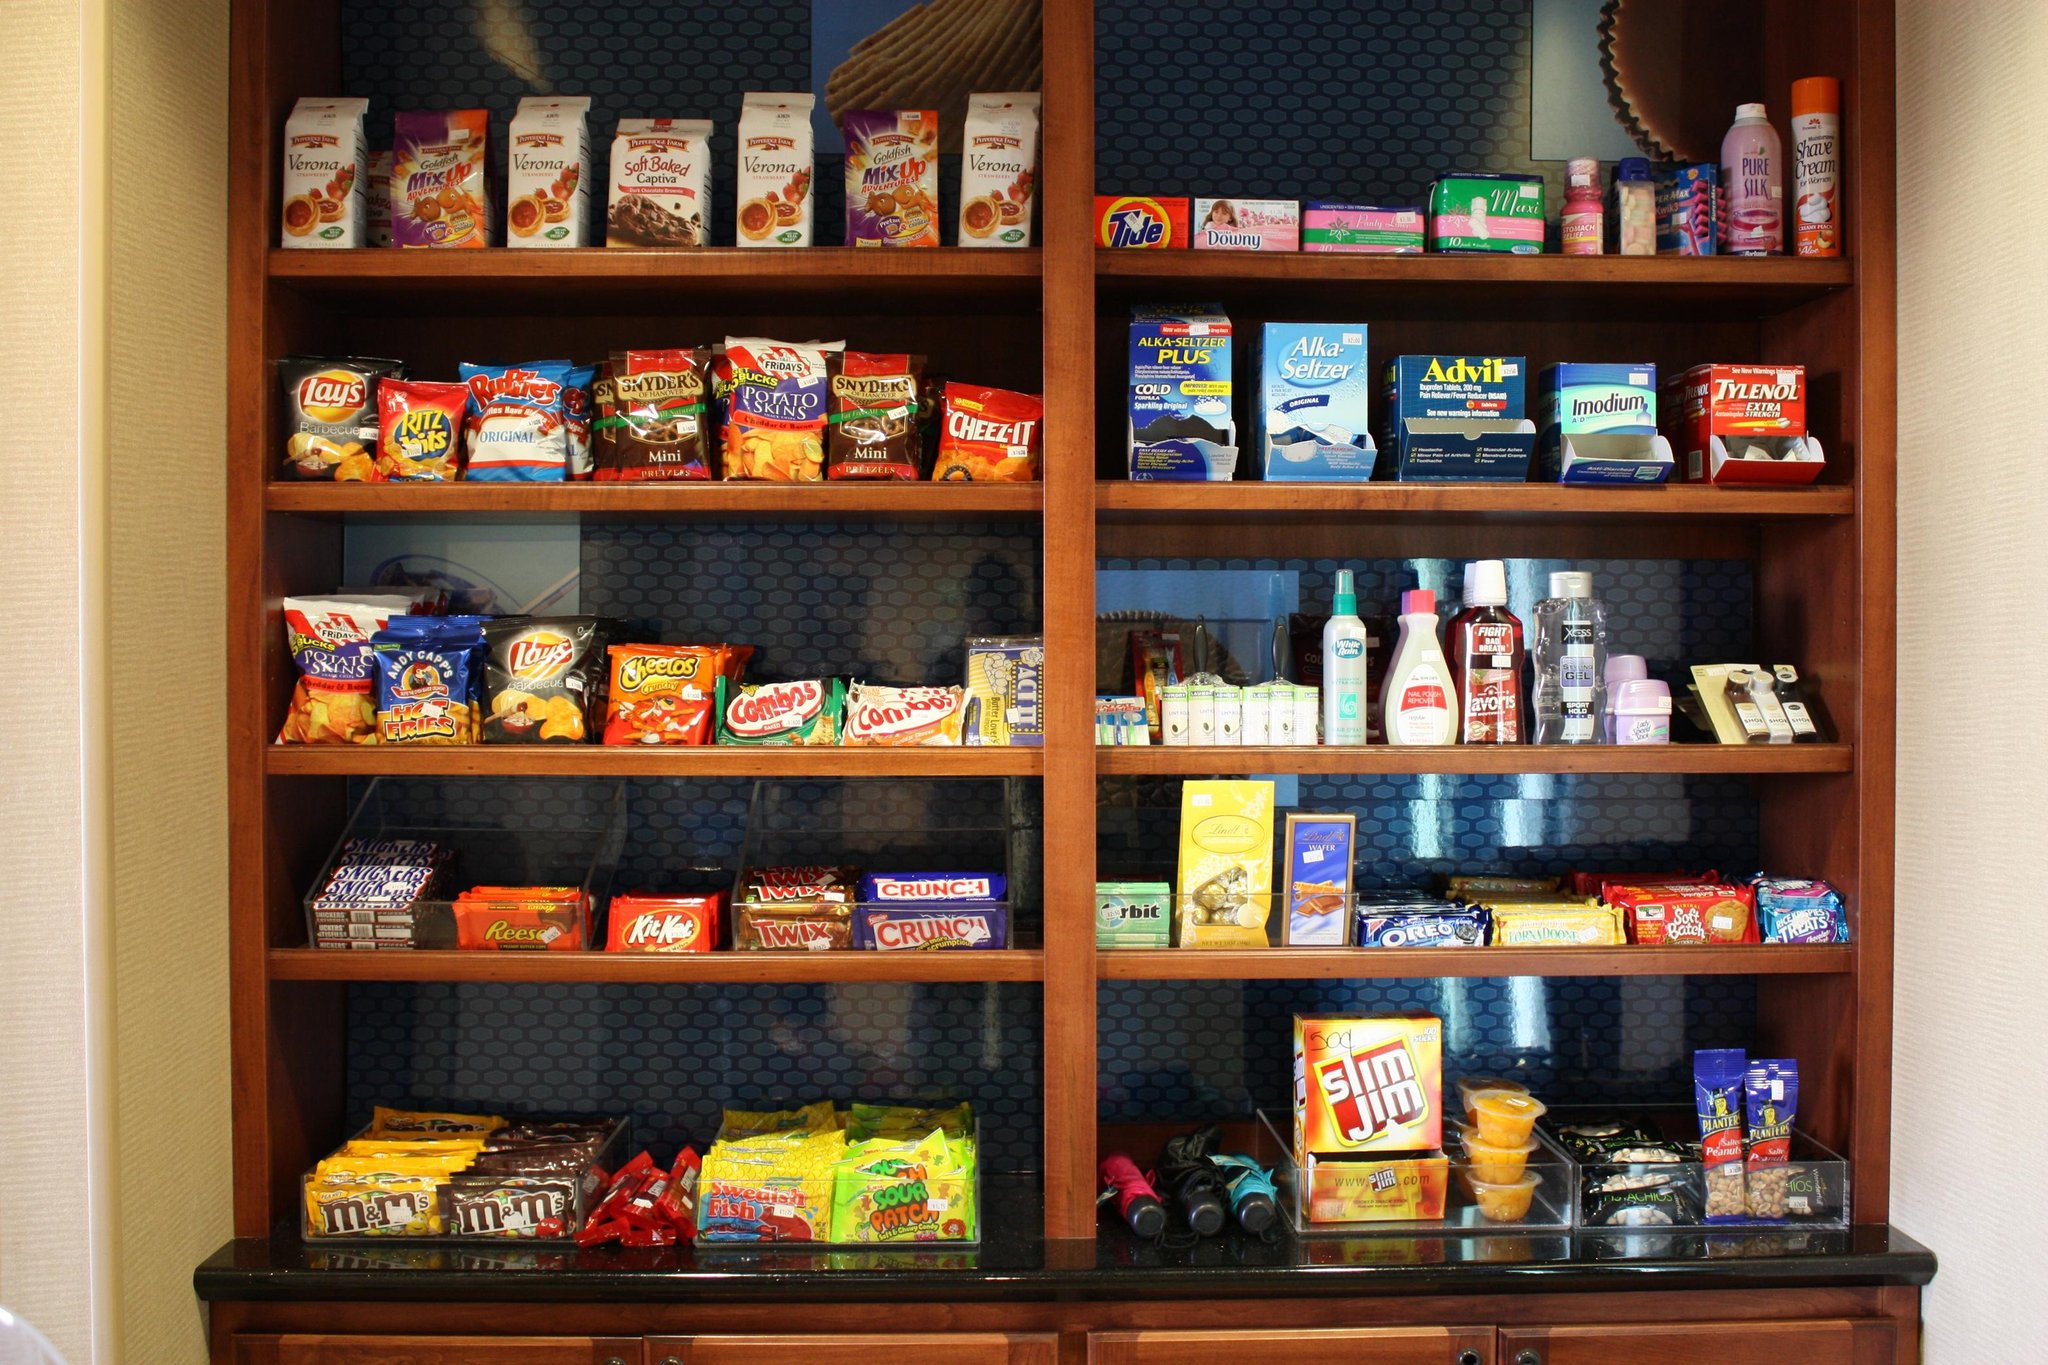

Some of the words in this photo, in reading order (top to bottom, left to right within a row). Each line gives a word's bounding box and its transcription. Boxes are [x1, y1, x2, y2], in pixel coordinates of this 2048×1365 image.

[631, 138, 666, 148] PEPPERIDGE
[667, 139, 683, 148] FARM
[1796, 139, 1833, 161] Shave
[289, 153, 340, 171] Verona
[420, 152, 459, 170] Goldfish
[513, 153, 564, 171] Verona
[873, 144, 912, 165] Goldfish
[968, 153, 1021, 172] Verona
[624, 155, 649, 176] Soft
[648, 155, 691, 177] Baked
[743, 156, 796, 174] Verona
[862, 156, 927, 186] Mix-Up
[1742, 157, 1770, 177] PURE
[1795, 159, 1836, 180] Cream
[406, 162, 472, 193] Mix-Up
[636, 173, 677, 186] Captiva
[1808, 176, 1832, 186] Women
[1744, 178, 1770, 201] SILK
[1490, 188, 1539, 216] Maxi
[1108, 208, 1165, 248] Tide
[1562, 224, 1596, 234] STOMACH
[1207, 229, 1261, 248] Downy
[1138, 337, 1226, 347] ALKA-SELTZER
[1291, 336, 1345, 358] Alka-
[1157, 349, 1212, 364] PLUS
[1281, 357, 1354, 380] Seltzer
[1420, 357, 1505, 383] Advil
[1731, 367, 1741, 375] See
[1752, 368, 1776, 376] Warnings
[622, 373, 699, 393] SNYDER'S
[738, 371, 779, 387] BUCKS
[1419, 383, 1443, 392] Ibuprofen
[1443, 383, 1463, 392] Tablets,
[1472, 385, 1482, 393] mg
[303, 378, 363, 408] Lay's
[468, 369, 561, 412] Ruffles
[649, 388, 684, 398] HANOVER
[745, 386, 819, 408] POTATO
[1134, 384, 1171, 396] COLD
[1419, 391, 1431, 399] Pain
[1431, 391, 1467, 400] Reliever/Fever
[1467, 392, 1488, 400] Reducer
[1714, 379, 1799, 400] TYLENOL
[753, 400, 807, 420] SKINS
[1134, 402, 1163, 411] Sparkling
[1163, 402, 1188, 411] Original
[1289, 396, 1320, 408] ORIGINAL
[1572, 393, 1645, 417] Imodium
[1745, 402, 1781, 412] EXTRA
[1426, 409, 1436, 417] See
[1447, 409, 1471, 418] warnings
[1471, 409, 1500, 417] information
[300, 422, 360, 435] Barbecue
[401, 410, 445, 436] RITZ
[949, 411, 1036, 447] CHEEZ-IT
[480, 431, 536, 444] ORIGINAL
[648, 449, 682, 463] Mini
[854, 447, 888, 459] Mini
[1477, 626, 1508, 637] FIGHT
[1336, 640, 1361, 649] White
[1478, 644, 1506, 652] BREATH
[1485, 637, 1500, 645] BAD
[1337, 647, 1359, 656] Rain
[311, 661, 365, 679] SKINS
[387, 651, 414, 680] ANDY
[417, 650, 454, 679] CAPP'S
[620, 656, 699, 691] Cheetos
[1565, 671, 1591, 681] GEL
[731, 682, 817, 725] Combos
[991, 696, 1001, 719] Butter
[1407, 697, 1435, 705] REMOVER
[385, 716, 456, 741] FRIES
[764, 722, 782, 732] BAKED
[990, 719, 1001, 744] Lover's
[1308, 844, 1336, 852] WAFER
[1673, 908, 1700, 925] Soft
[1381, 923, 1453, 947] OREO
[1666, 922, 1706, 940] Batch
[1423, 1026, 1438, 1036] 100
[1322, 1048, 1416, 1105] slim
[1348, 1079, 1425, 1141] jim
[1750, 1123, 1790, 1140] PLANTERS
[1705, 1146, 1742, 1157] Peanuts
[1749, 1153, 1788, 1162] Peanuts
[1398, 1174, 1430, 1185] .com
[320, 1192, 343, 1200] PEANUT
[711, 1177, 807, 1207] Swedish
[874, 1181, 930, 1210] SOUR
[707, 1199, 757, 1221] Fish
[870, 1202, 939, 1232] PATCH
[877, 1230, 893, 1241] Soft
[897, 1225, 920, 1237] Chewy
[918, 1223, 939, 1233] Candy
